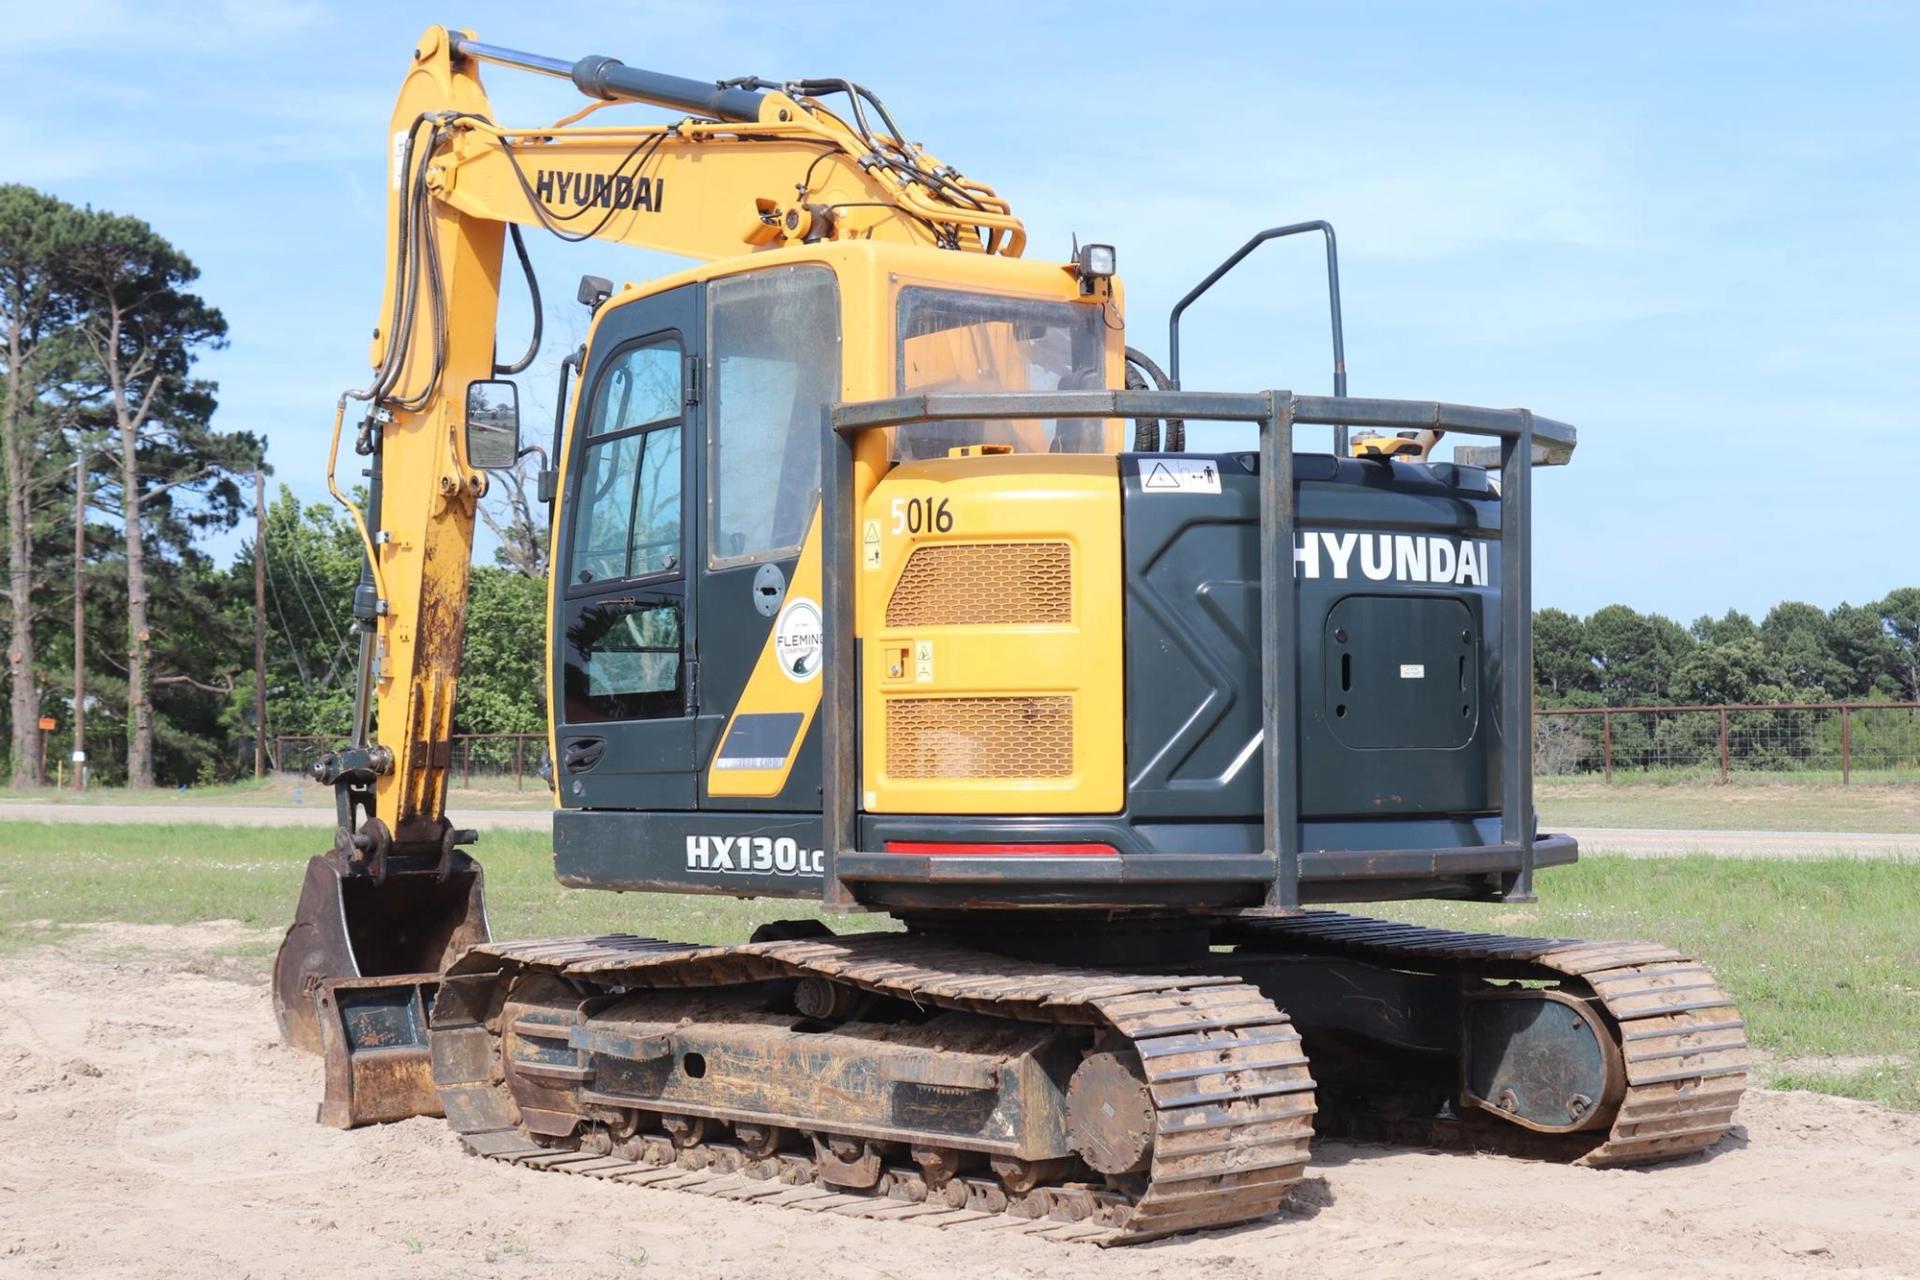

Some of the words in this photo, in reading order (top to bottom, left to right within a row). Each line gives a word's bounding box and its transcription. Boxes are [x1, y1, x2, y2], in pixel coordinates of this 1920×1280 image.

[537, 170, 664, 213] HYUNDAI
[890, 496, 953, 535] 5016
[1293, 531, 1489, 586] HYUNDAI
